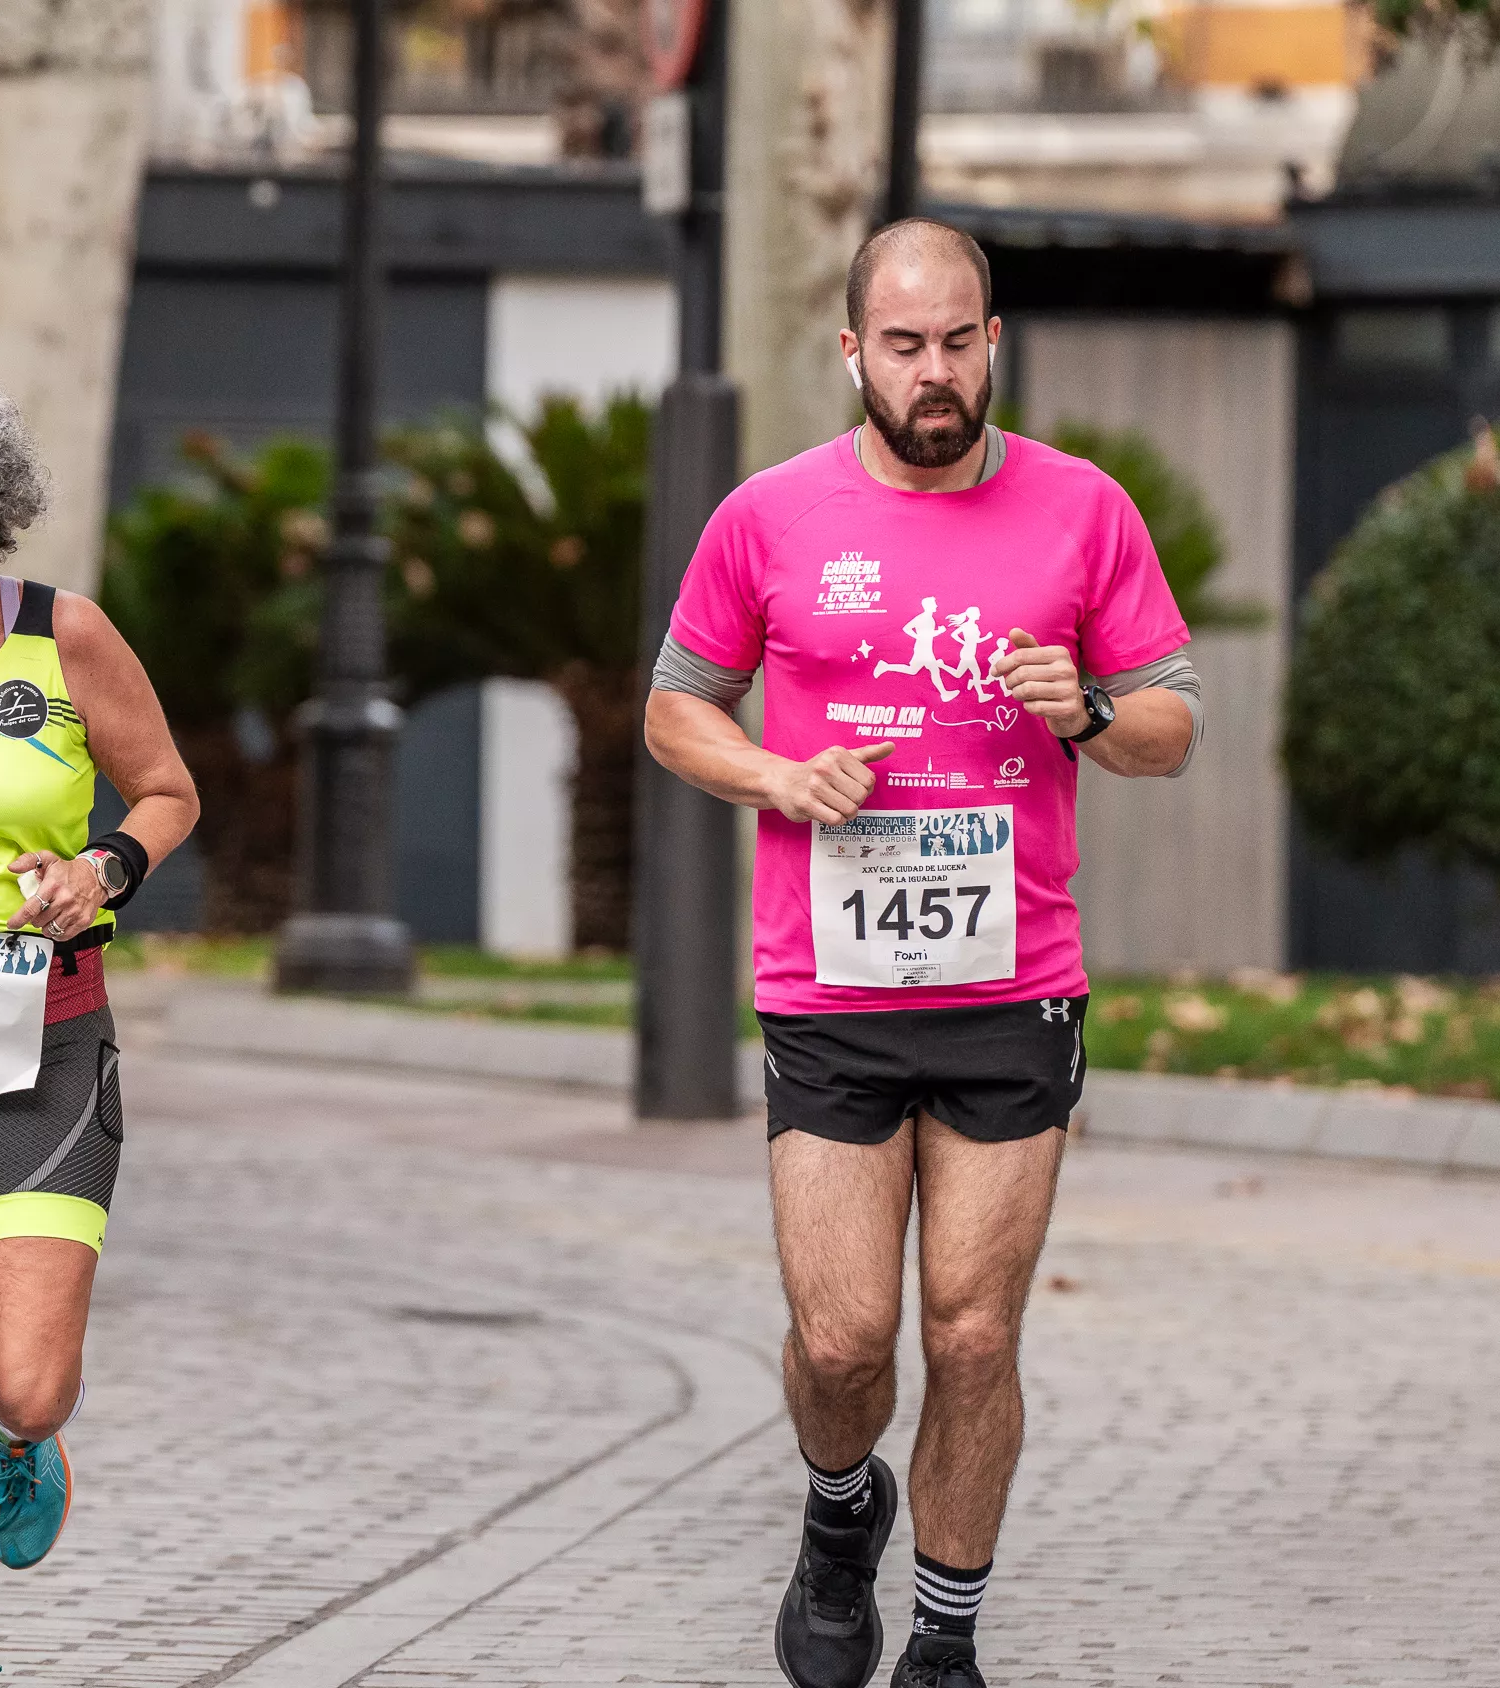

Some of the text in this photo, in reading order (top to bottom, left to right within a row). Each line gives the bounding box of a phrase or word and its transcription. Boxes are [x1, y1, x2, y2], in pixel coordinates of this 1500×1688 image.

[840, 551, 863, 560] XXV
[822, 560, 880, 575] CARRERA
[820, 574, 881, 584] POPULAR
[816, 591, 881, 603] LUCENA
[826, 702, 926, 725] SUMANDO KM
[856, 725, 922, 738] POR LA IGUALDAD
[856, 817, 903, 826] PROVINCIAL
[905, 817, 916, 826] DE
[919, 814, 971, 836] 2024
[819, 825, 917, 835] CARRERAS POPULARES
[819, 834, 861, 843] DIPUTACIÓN
[880, 835, 917, 843] CÓRDOBA
[862, 866, 878, 874] XXV
[895, 865, 923, 873] CIUDAD
[925, 864, 936, 872] DE
[937, 863, 967, 872] LUCENA
[879, 876, 894, 884] POR
[908, 875, 948, 883] IGUALDAD
[842, 885, 991, 940] 1457
